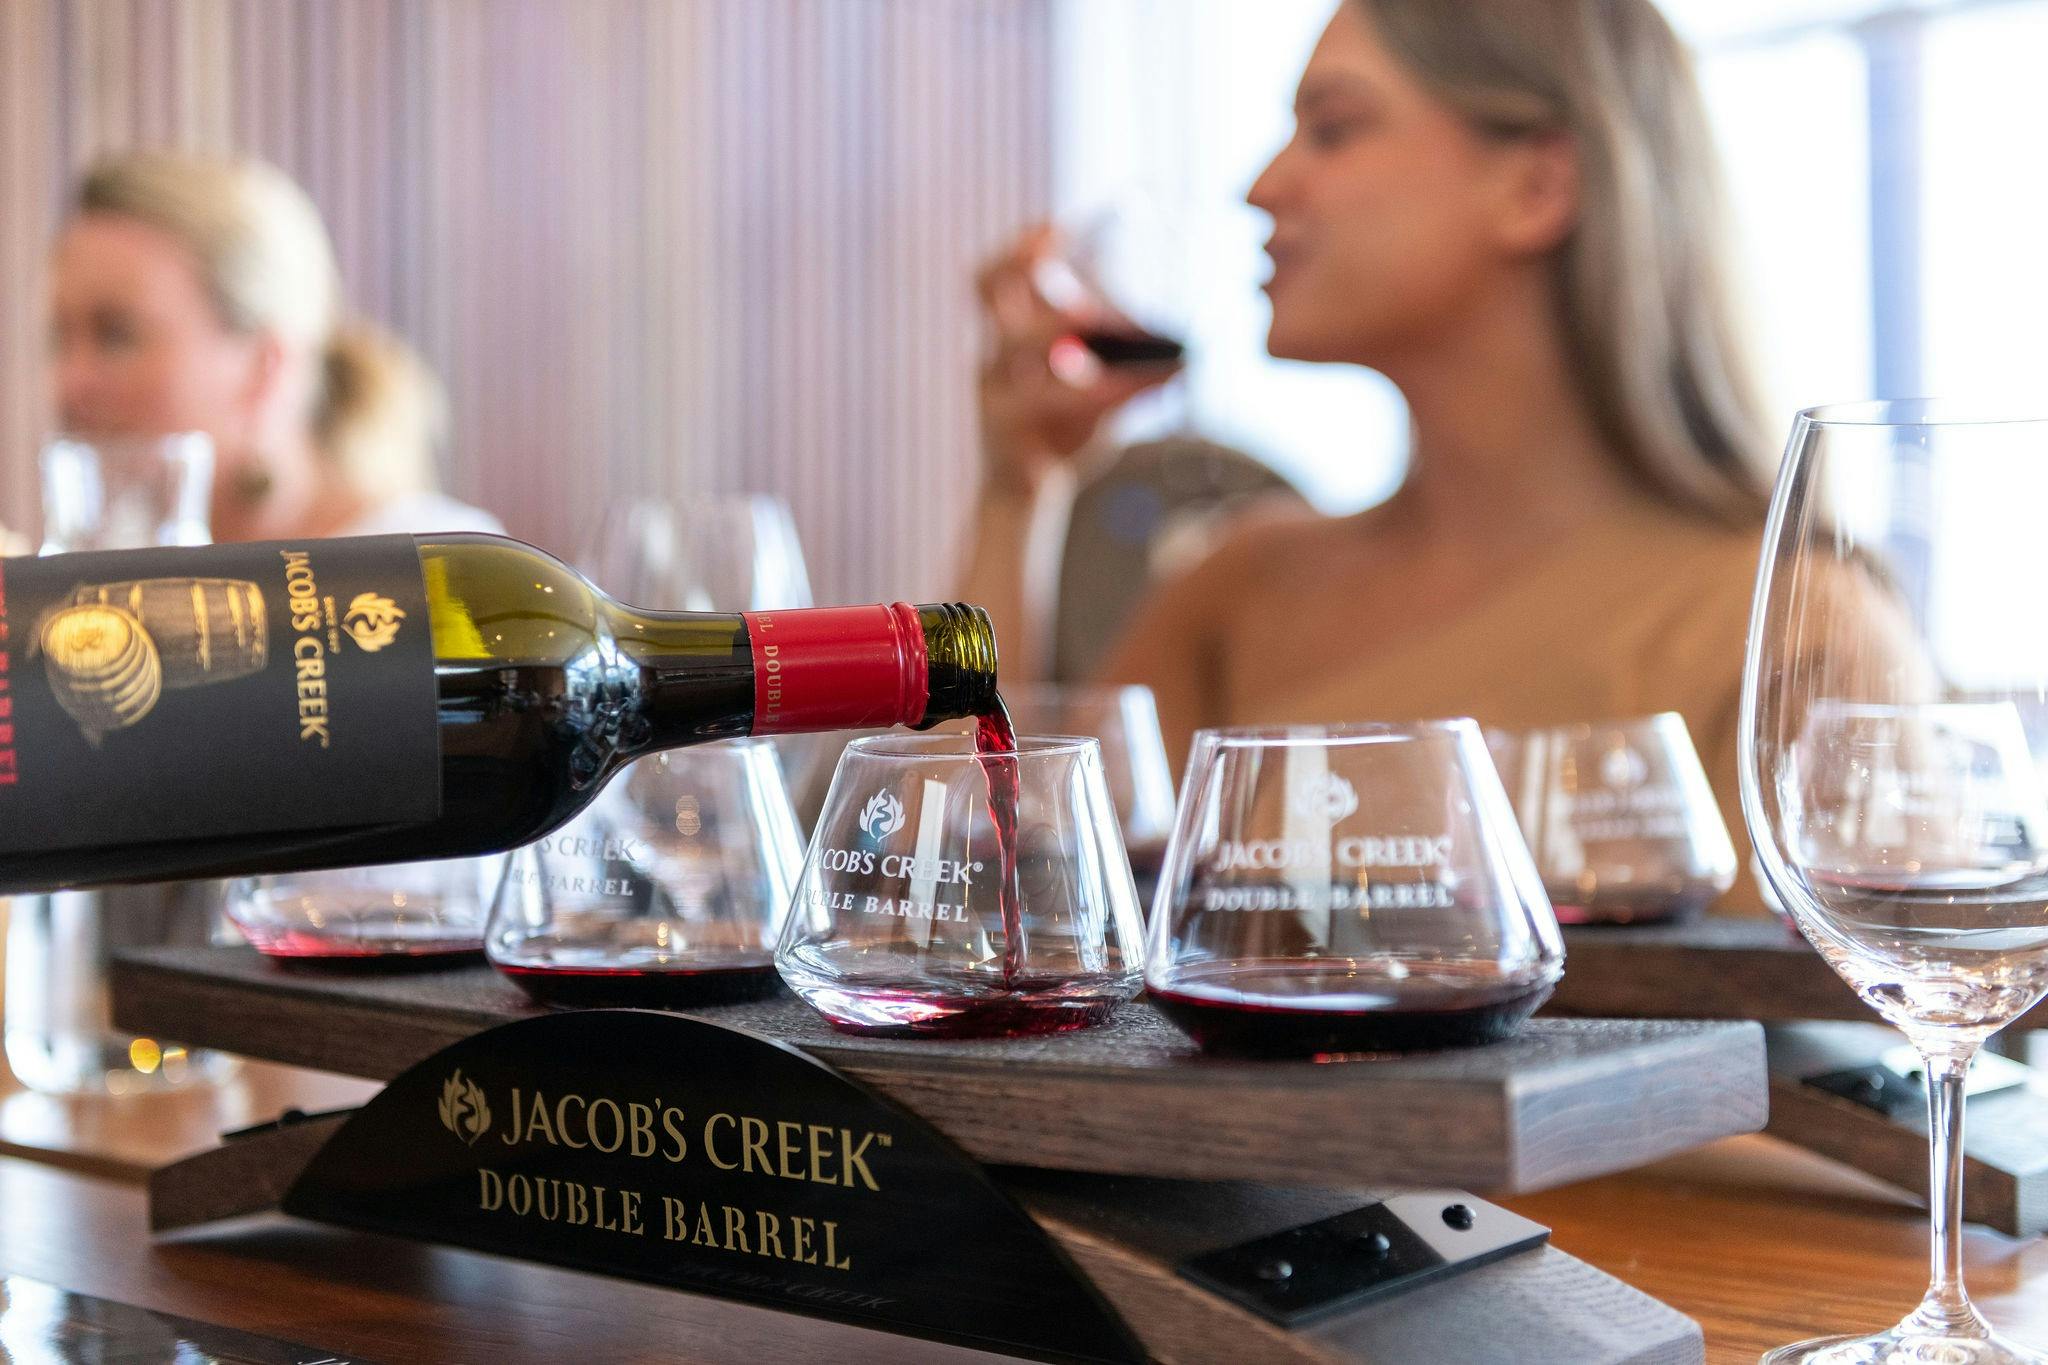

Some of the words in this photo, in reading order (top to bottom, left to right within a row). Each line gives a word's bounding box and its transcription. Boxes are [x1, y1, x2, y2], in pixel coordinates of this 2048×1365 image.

[280, 550, 323, 632] JACOB'S
[764, 645, 781, 723] DOUBLE
[808, 847, 876, 876] ACOB'S
[1213, 838, 1330, 873] JACO
[863, 895, 969, 924] BARREL
[1331, 882, 1455, 909] BARREL
[502, 1087, 687, 1162] JACOB'S
[478, 1168, 645, 1236] DOUBLE
[661, 1196, 852, 1271] BARREL
